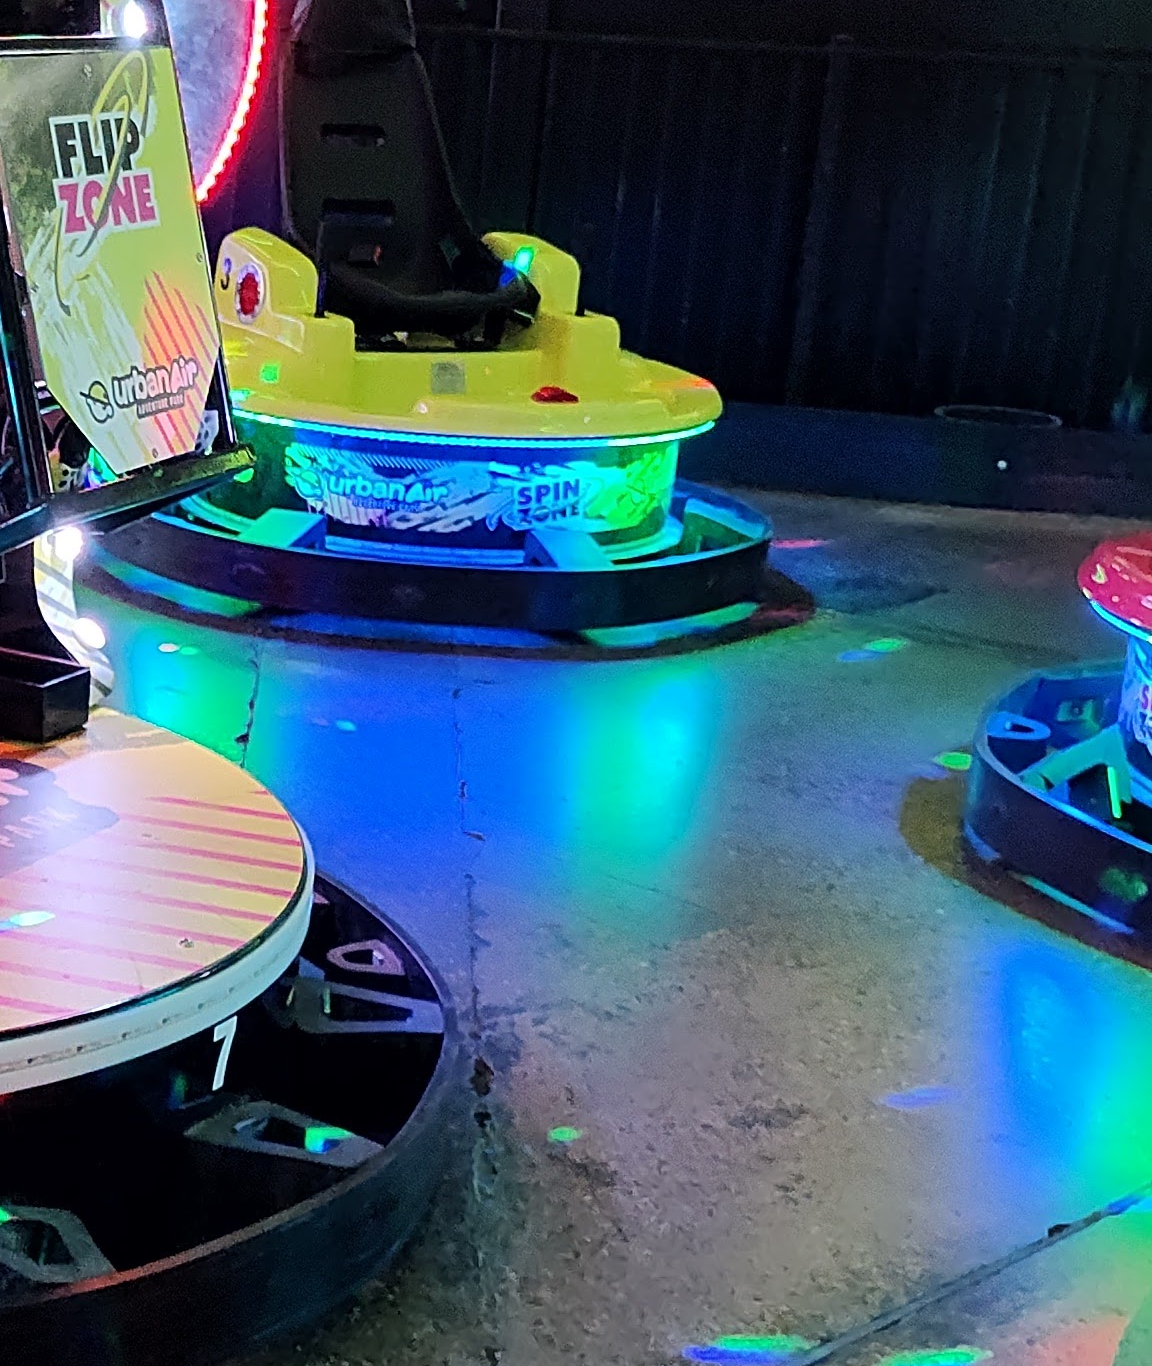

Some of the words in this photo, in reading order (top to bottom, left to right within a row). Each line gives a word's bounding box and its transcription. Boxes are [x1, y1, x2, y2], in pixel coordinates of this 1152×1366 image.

[53, 117, 140, 178] FLIP
[57, 173, 157, 235] ZONE
[220, 257, 233, 291] 3
[517, 478, 580, 506] SPIN
[517, 504, 580, 525] ZONE
